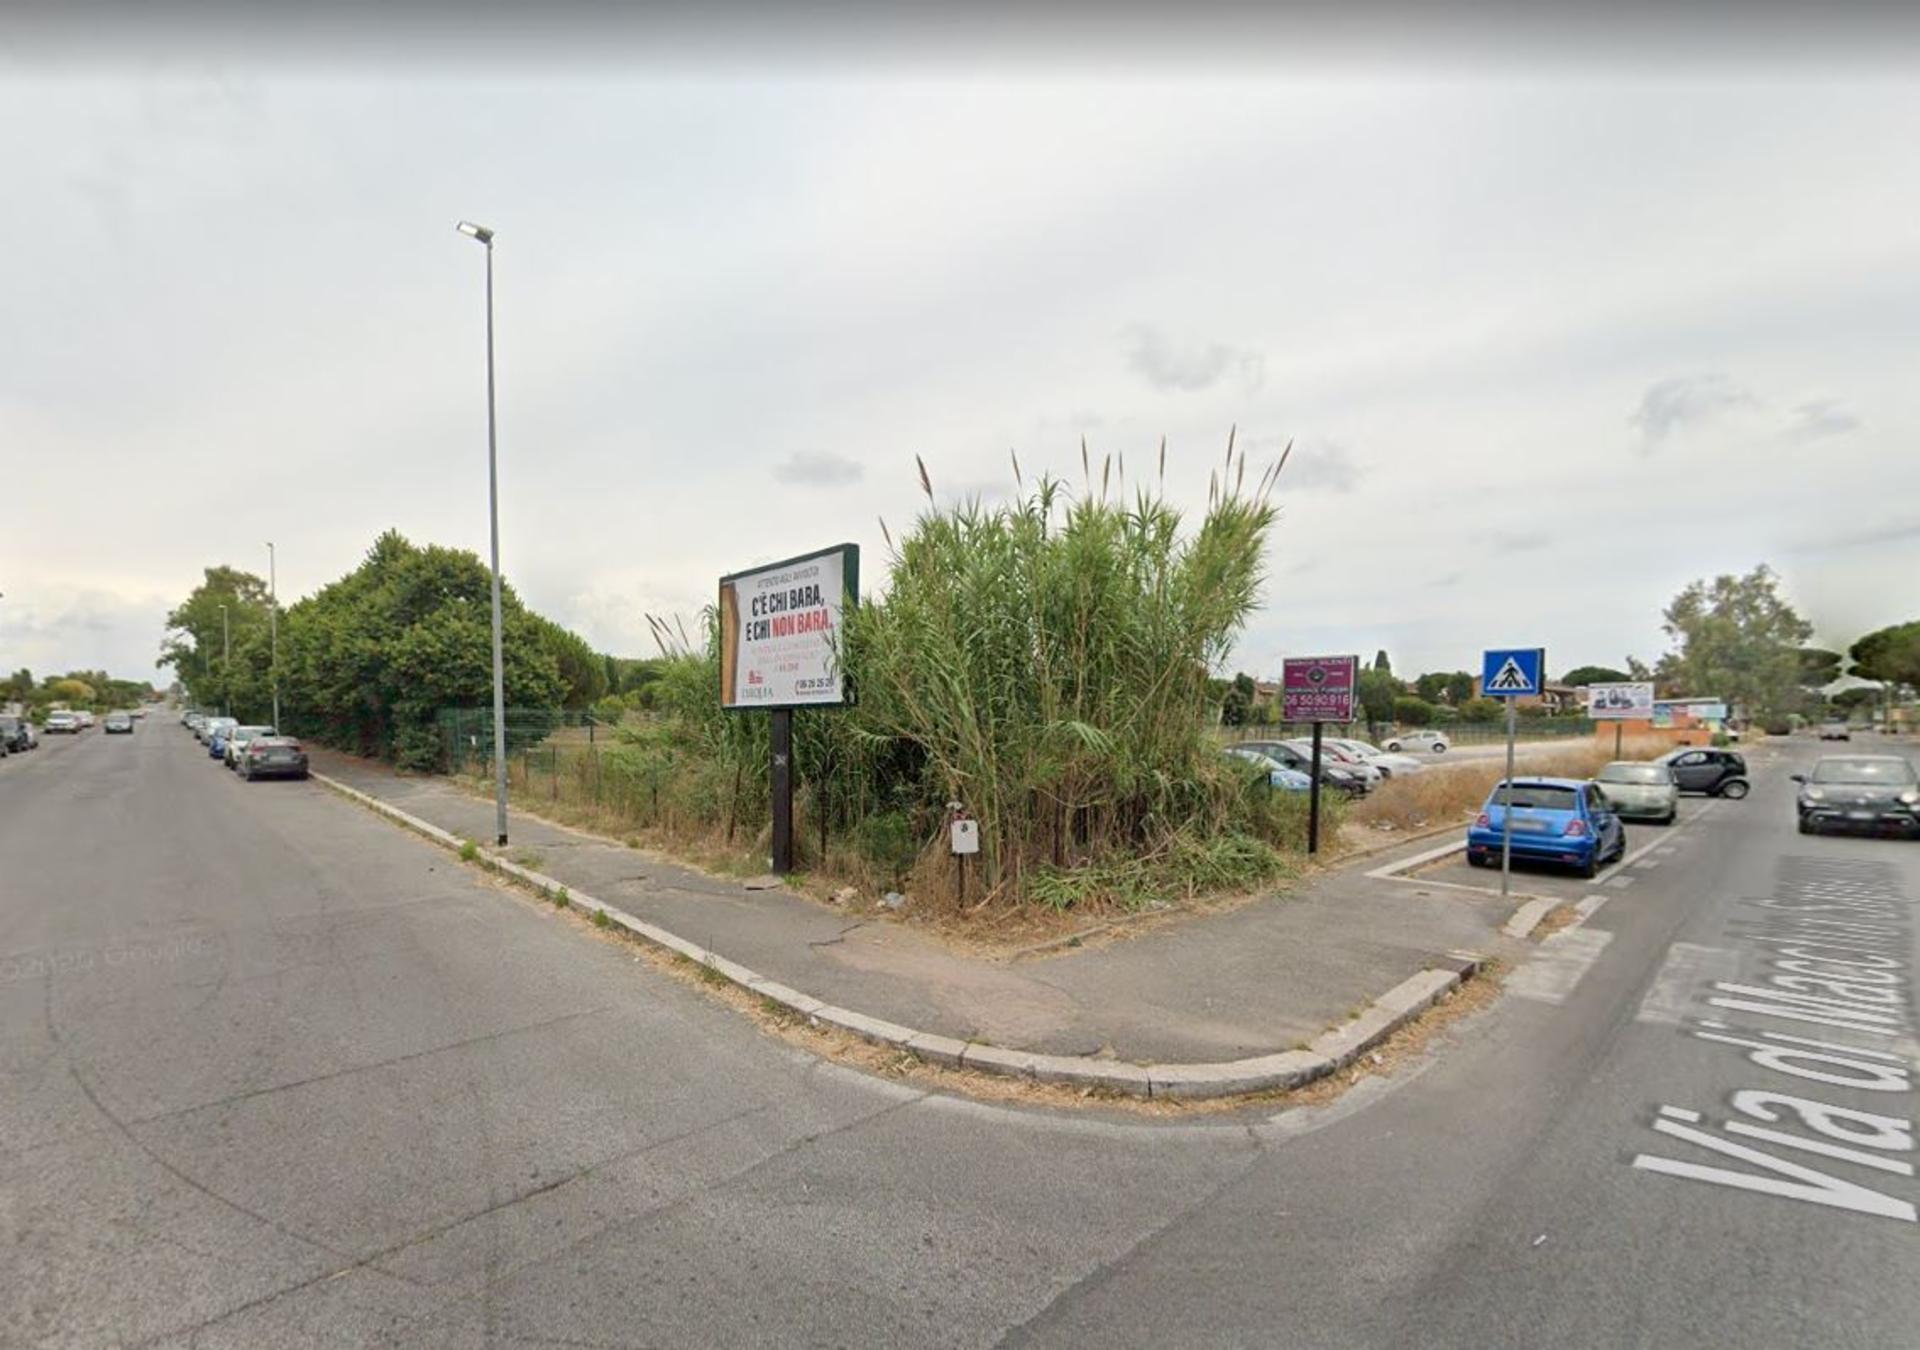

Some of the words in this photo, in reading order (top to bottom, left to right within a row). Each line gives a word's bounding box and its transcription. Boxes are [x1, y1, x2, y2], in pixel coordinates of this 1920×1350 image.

[769, 591, 787, 613] CHI
[789, 584, 825, 610] BARA,
[746, 622, 752, 641] E
[753, 619, 770, 641] CHI
[772, 613, 795, 637] NON
[797, 608, 833, 634] BARA.
